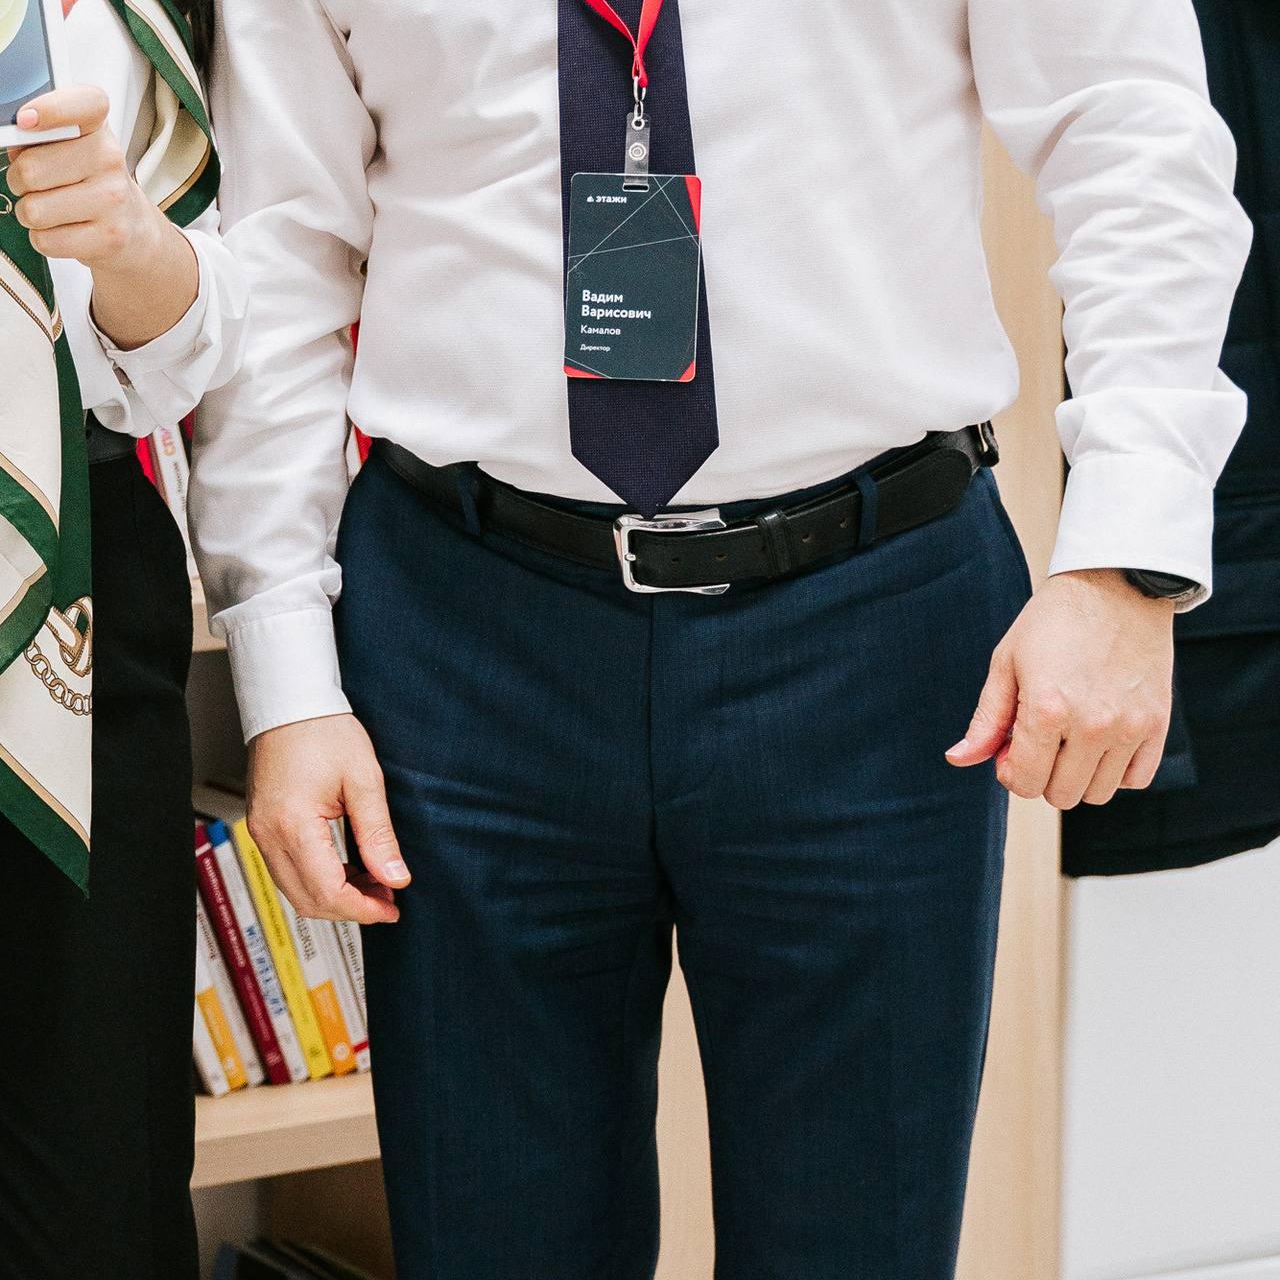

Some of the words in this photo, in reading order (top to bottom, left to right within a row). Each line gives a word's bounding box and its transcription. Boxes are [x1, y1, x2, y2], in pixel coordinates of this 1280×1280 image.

[596, 195, 627, 204] этажи
[582, 290, 623, 303] Вадим
[581, 305, 651, 319] Варисович
[580, 325, 621, 335] Камалов
[580, 344, 611, 352] Директор
